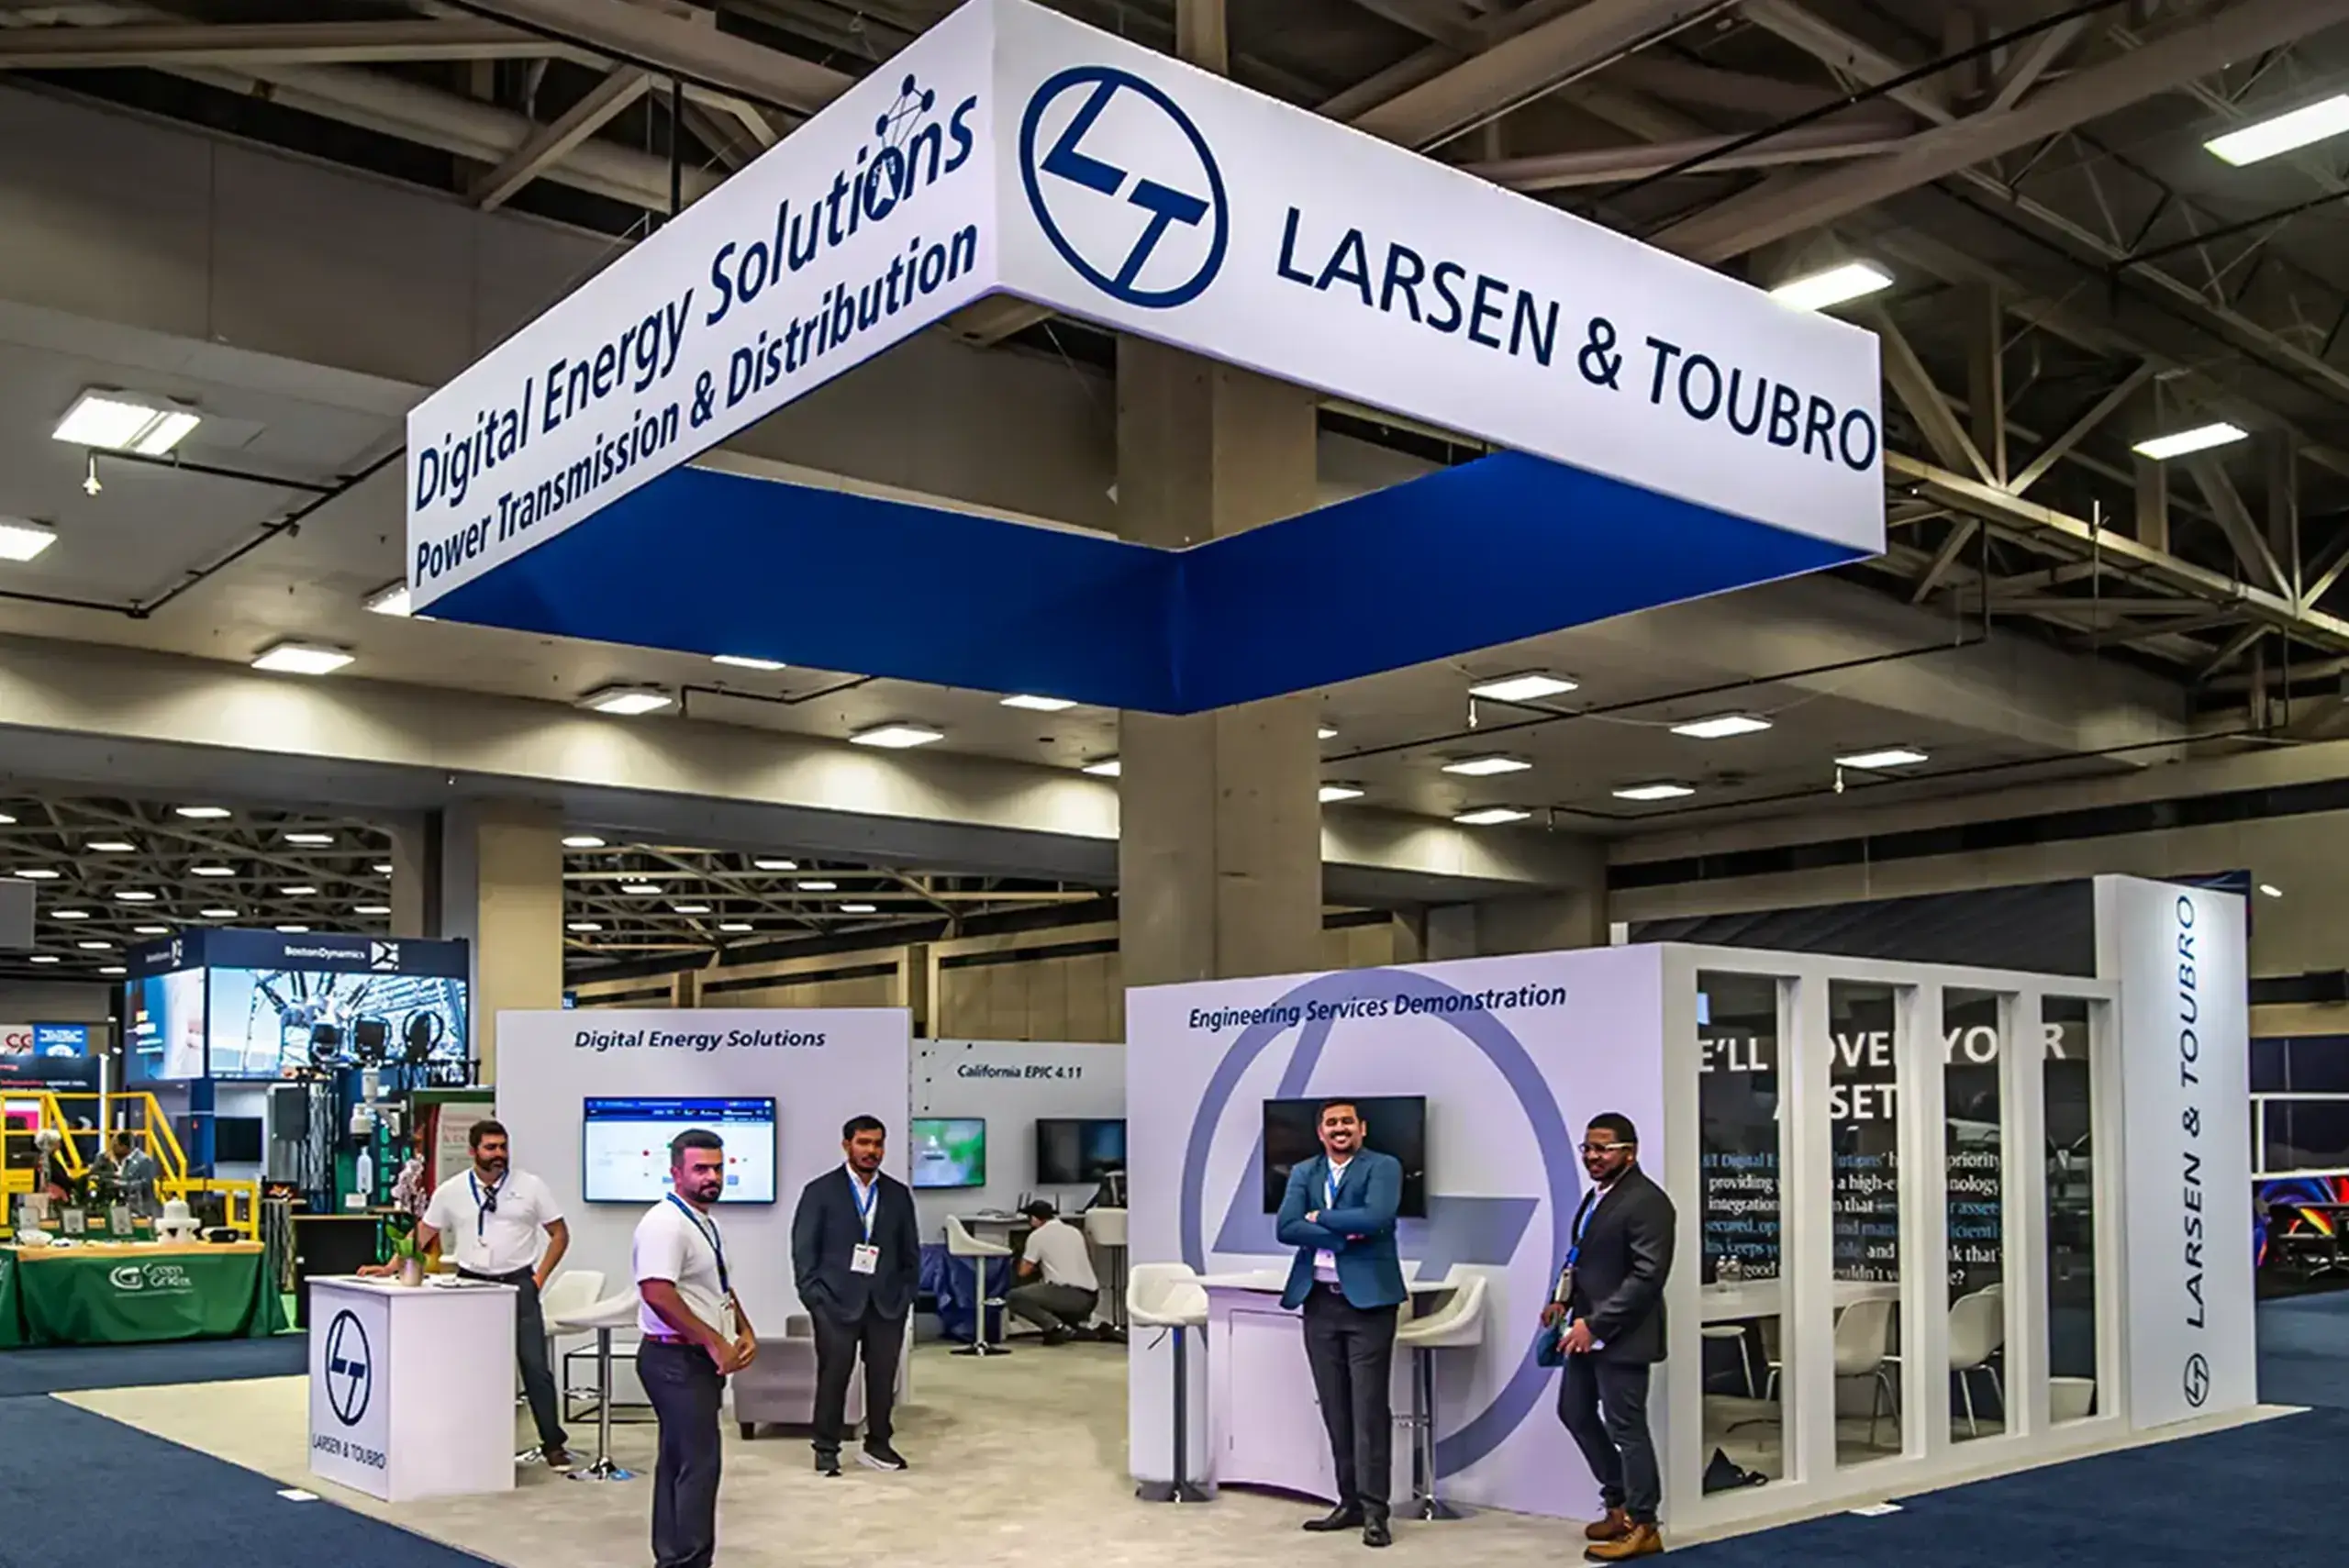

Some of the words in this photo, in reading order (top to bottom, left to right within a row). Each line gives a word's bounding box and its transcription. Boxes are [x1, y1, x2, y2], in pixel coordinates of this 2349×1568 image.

[416, 377, 533, 511] Digital
[542, 287, 695, 435] Energy
[706, 95, 977, 328] Solutions
[1276, 206, 1560, 367] LARSEN
[1577, 317, 1623, 391] &
[1646, 336, 1877, 472] TOUBRO
[416, 514, 492, 587] Power
[498, 402, 680, 542] Transmission
[690, 370, 716, 428] &
[727, 224, 978, 408] Distribution
[574, 1029, 644, 1051] Digital
[648, 1030, 723, 1051] Energy
[727, 1029, 827, 1048] Solutions
[1189, 1001, 1301, 1033] Engineering
[1306, 995, 1388, 1022] Services
[1394, 984, 1566, 1016] Demonstration
[1698, 1037, 1768, 1072] E'LL
[1943, 1023, 2066, 1063] YOR
[2176, 895, 2199, 1087] TOUBRO
[957, 1064, 1021, 1079] California
[1024, 1065, 1053, 1079] EPIC
[1055, 1066, 1083, 1079] 4.11
[2182, 1106, 2200, 1138] &
[2183, 1151, 2204, 1329] LARSEN
